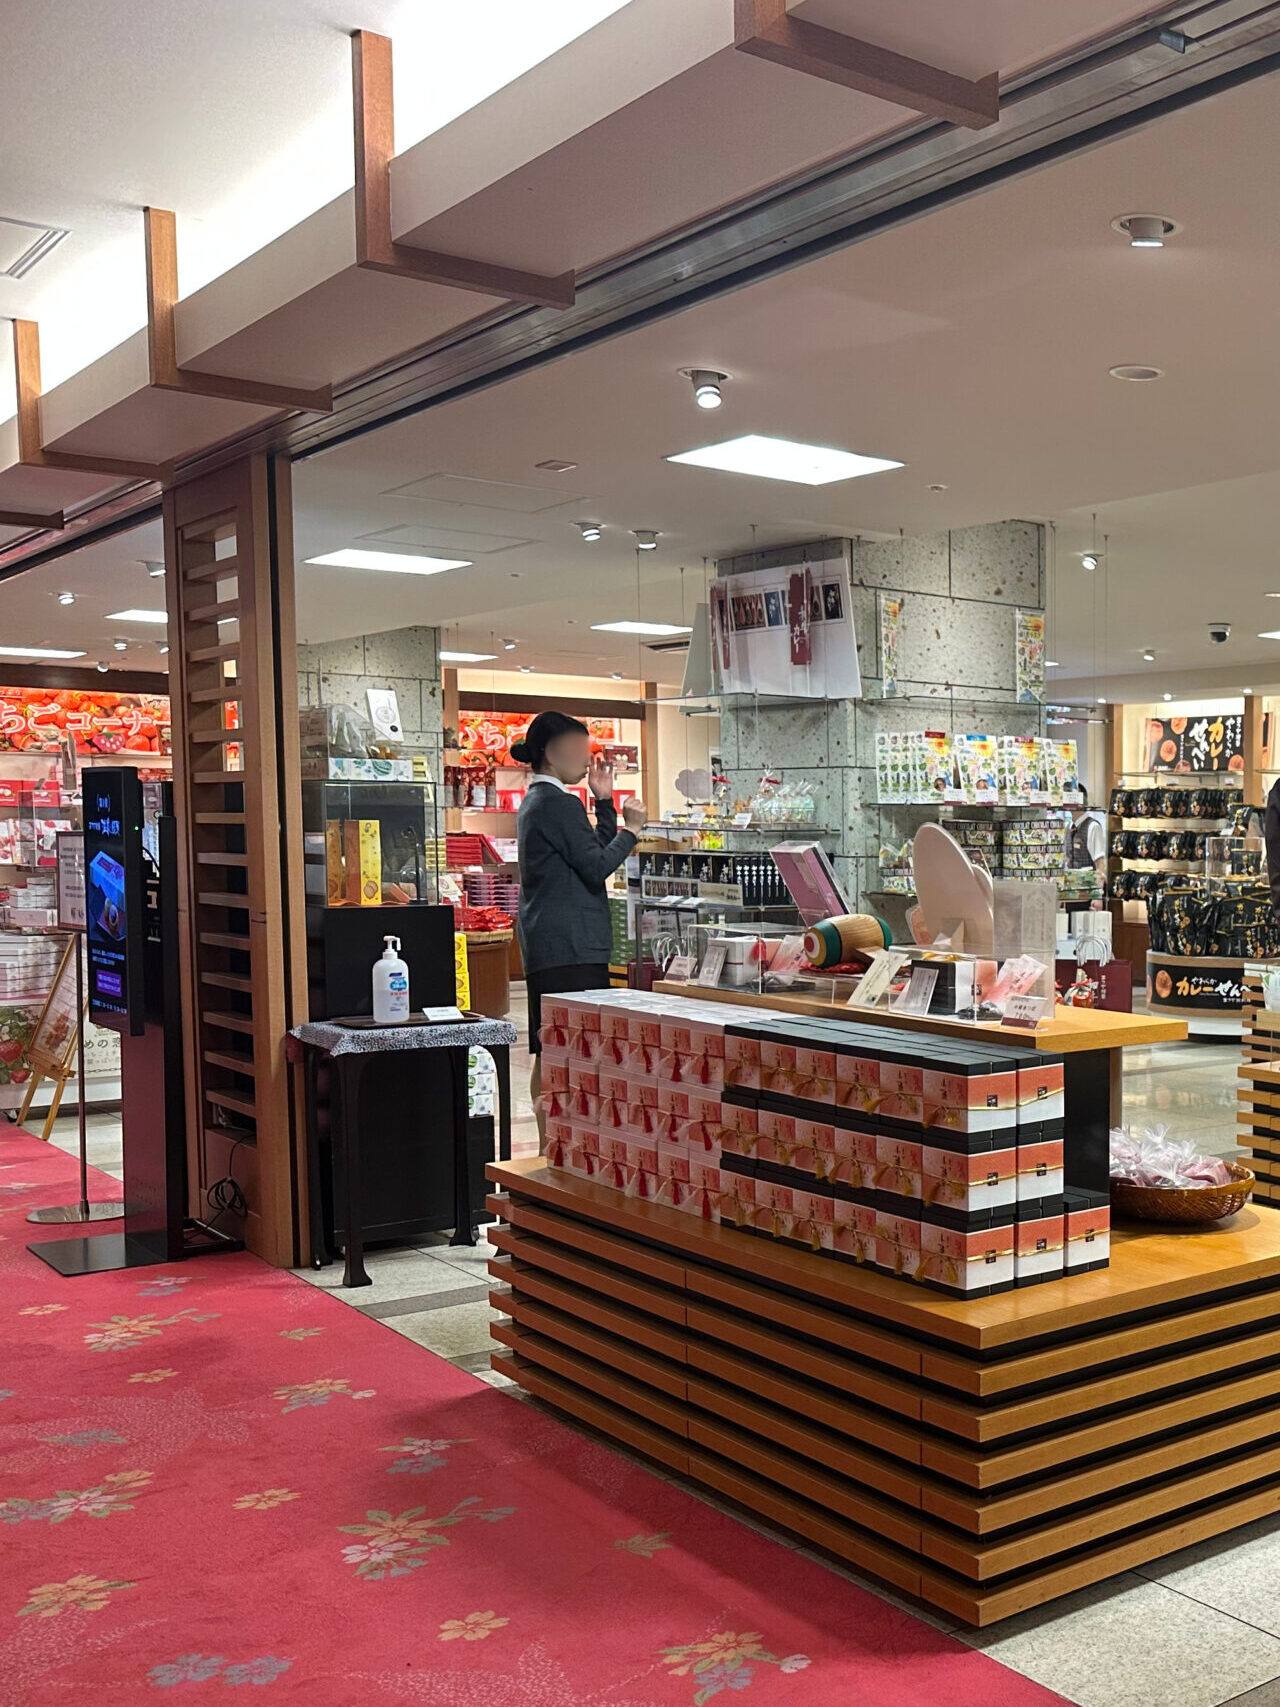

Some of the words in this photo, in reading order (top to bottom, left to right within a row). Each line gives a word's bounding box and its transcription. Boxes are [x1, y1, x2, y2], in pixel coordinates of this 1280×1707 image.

[1189, 718, 1210, 770] せんべい
[1208, 716, 1224, 771] カレー
